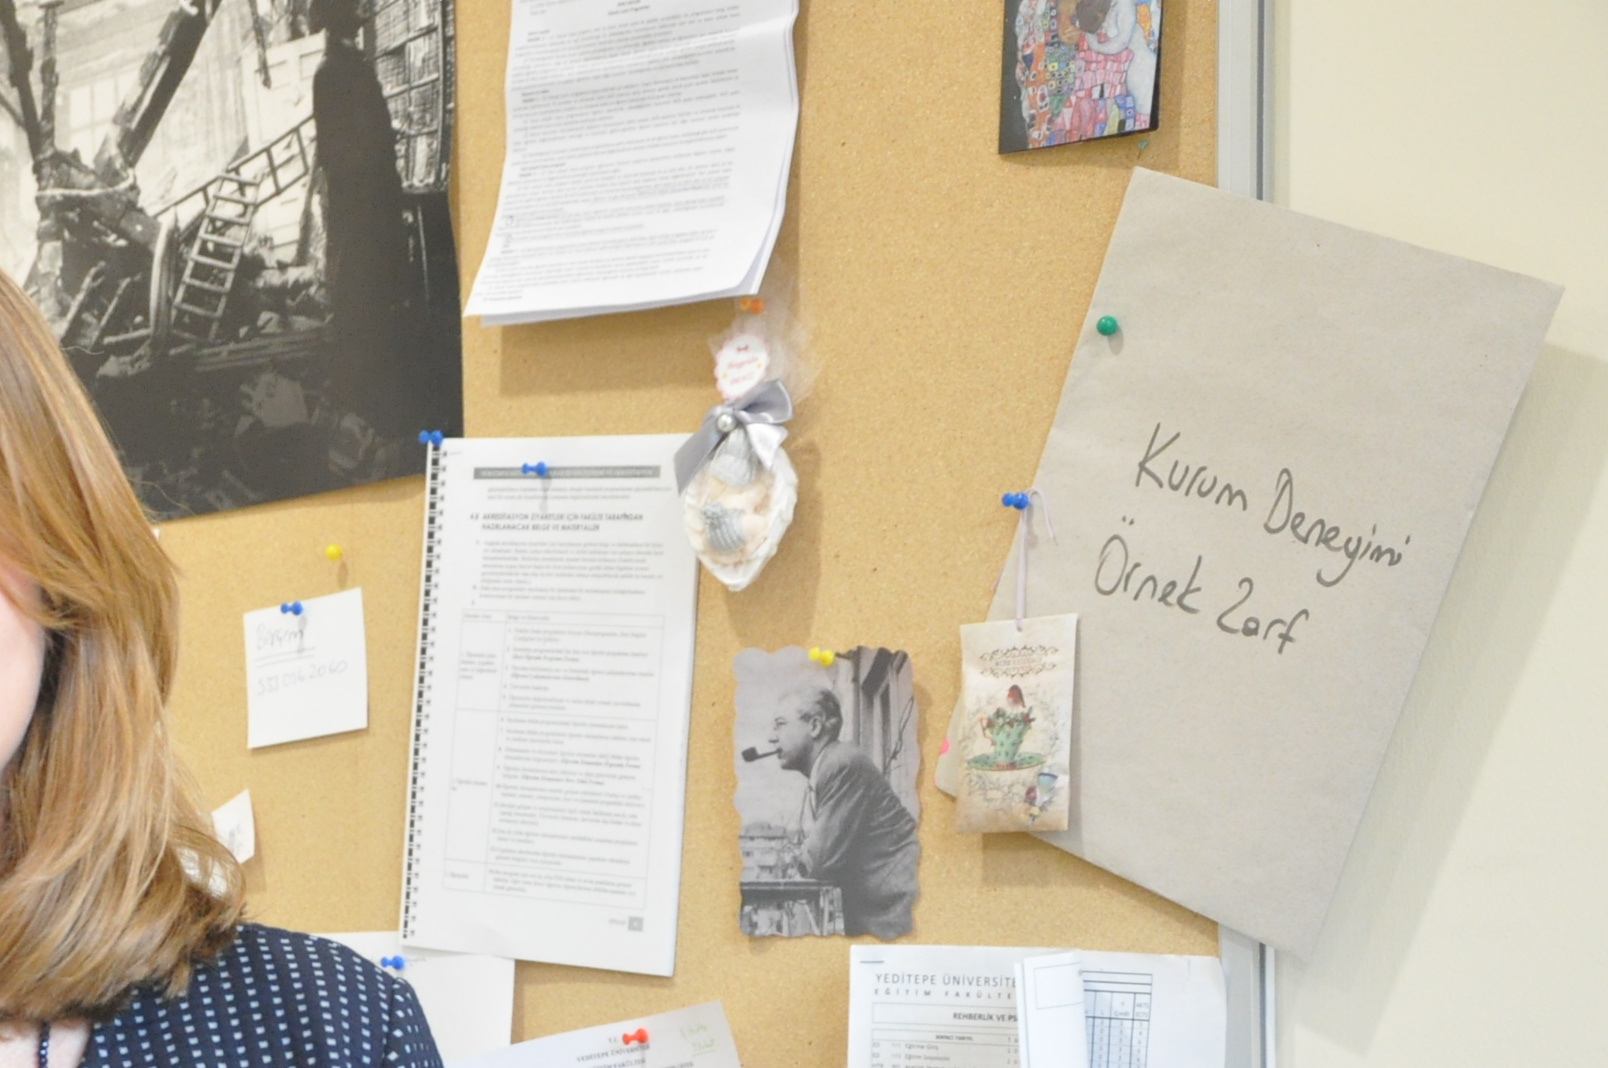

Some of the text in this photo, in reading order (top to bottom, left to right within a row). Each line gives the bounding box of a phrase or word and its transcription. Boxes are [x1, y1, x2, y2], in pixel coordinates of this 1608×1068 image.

[1136, 422, 1411, 587] Kurum Deneyimi
[532, 523, 551, 531] BELGE
[552, 523, 560, 531] VE
[1094, 515, 1309, 655] Örnek Zarf
[876, 973, 937, 985] YEDİTEPE
[874, 988, 932, 996] EĞİTİM
[953, 1012, 994, 1021] REHBERLİK
